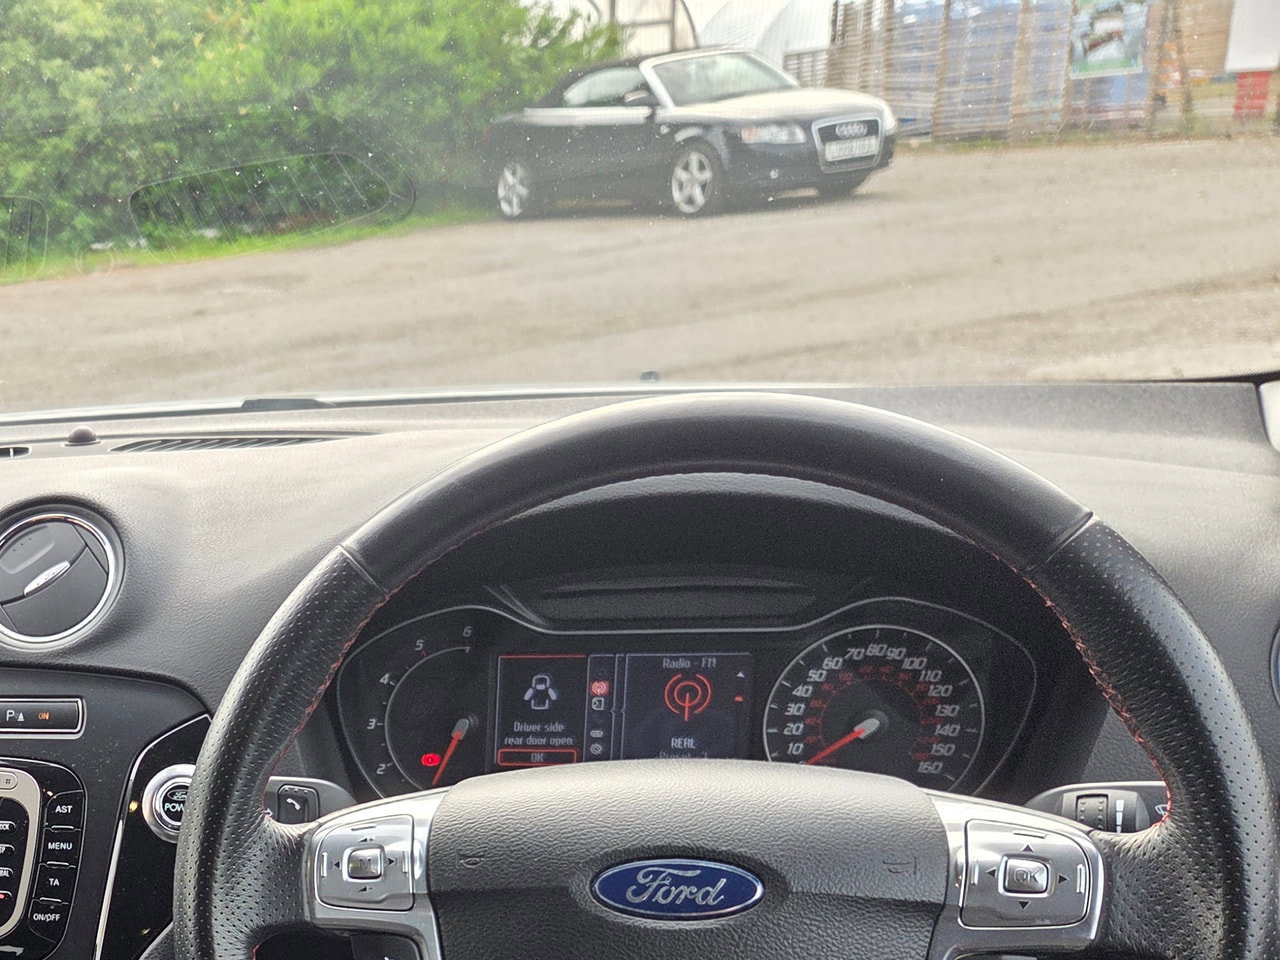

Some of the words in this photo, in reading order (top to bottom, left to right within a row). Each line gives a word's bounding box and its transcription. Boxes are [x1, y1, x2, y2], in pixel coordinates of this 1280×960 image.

[462, 626, 473, 637] 6
[414, 639, 425, 651] 5
[843, 648, 865, 660] 70
[886, 648, 907, 660] 90
[662, 657, 691, 669] Radio
[822, 657, 843, 670] 60
[901, 657, 927, 670] 100
[379, 673, 390, 685] 4
[806, 669, 827, 682] 50
[919, 669, 943, 682] 110
[791, 685, 813, 697] 40
[927, 684, 953, 697] 120
[38, 711, 50, 720] ON
[784, 703, 805, 716] 30
[366, 718, 376, 730] 3
[513, 721, 541, 732] Driver
[544, 721, 565, 732] side
[783, 723, 804, 735] 20
[934, 723, 961, 737] 140
[504, 737, 523, 745] rear
[526, 735, 546, 745] door
[549, 736, 573, 747] open
[670, 737, 696, 749] REAL
[787, 743, 804, 755] 10
[930, 743, 956, 756] 150
[530, 752, 544, 763] OK
[376, 763, 386, 775] 2
[55, 805, 73, 814] AST
[47, 842, 73, 850] MENU
[49, 878, 60, 886] TA
[1013, 868, 1040, 884] OK
[626, 867, 727, 906] Ford
[33, 913, 61, 922] ON/OFF
